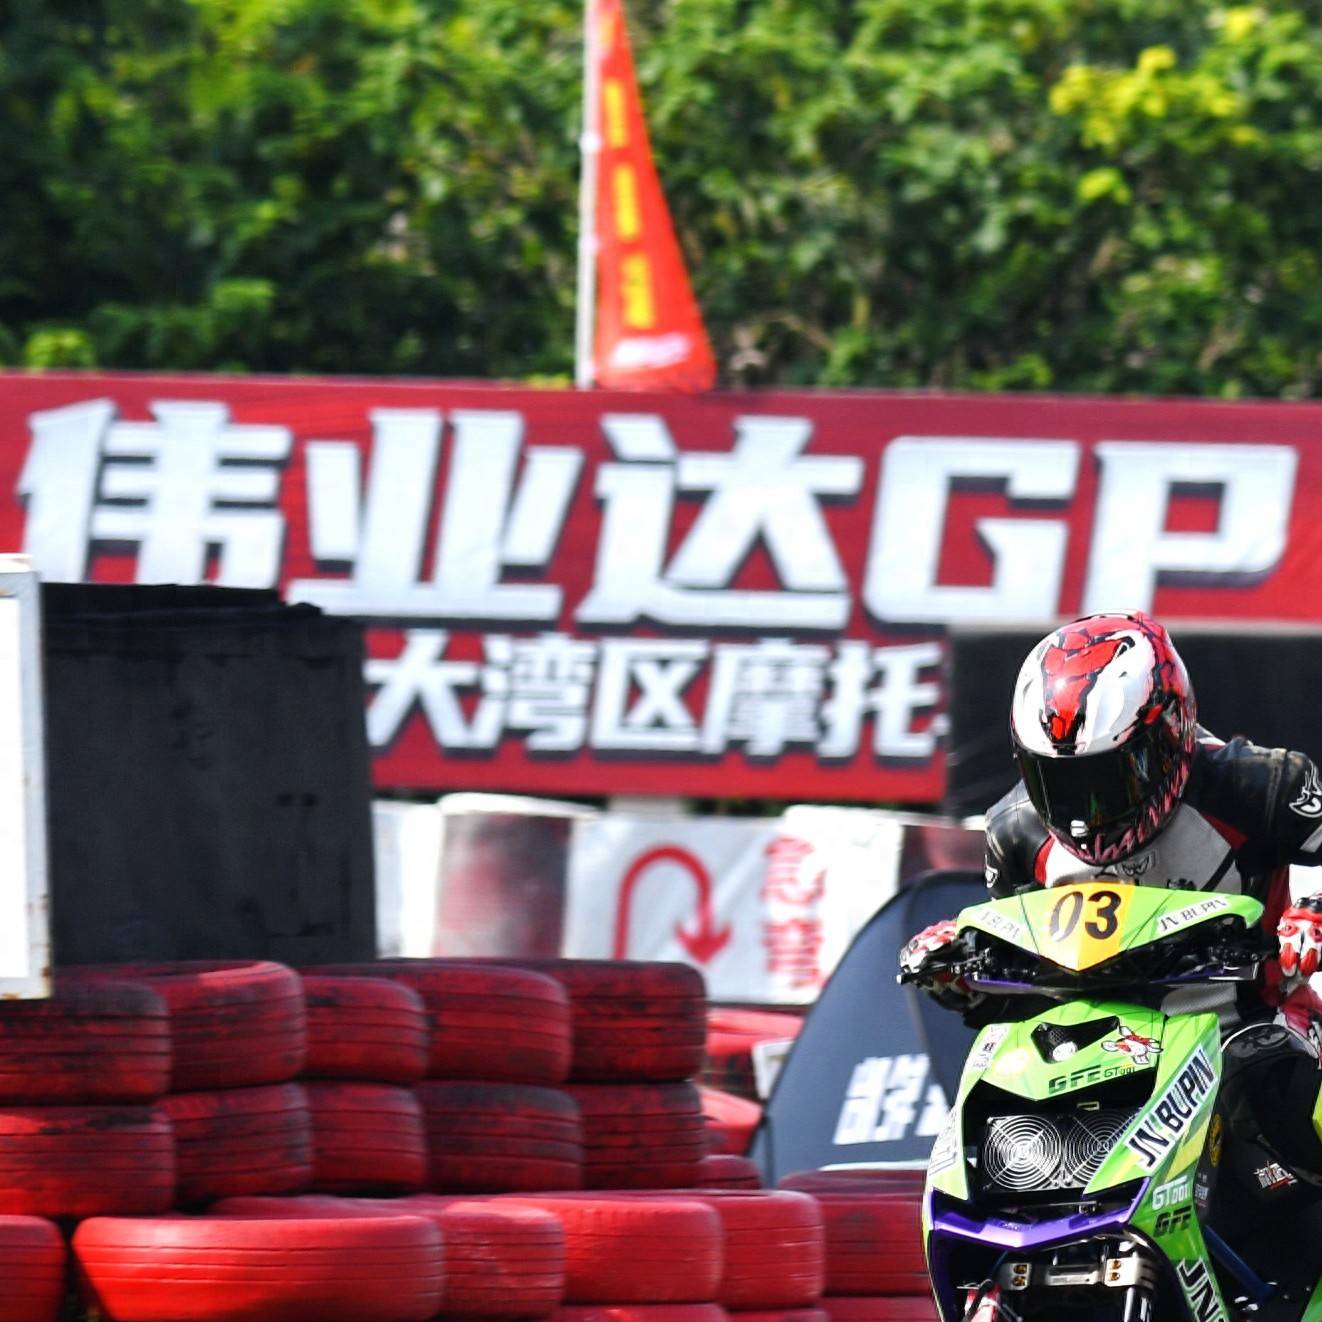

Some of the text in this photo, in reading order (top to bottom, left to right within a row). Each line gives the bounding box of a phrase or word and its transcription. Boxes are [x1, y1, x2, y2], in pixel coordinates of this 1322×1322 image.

[14, 396, 1300, 632] 伟业达GP
[1049, 890, 1122, 943] 03
[1157, 1049, 1215, 1143] BUPIN
